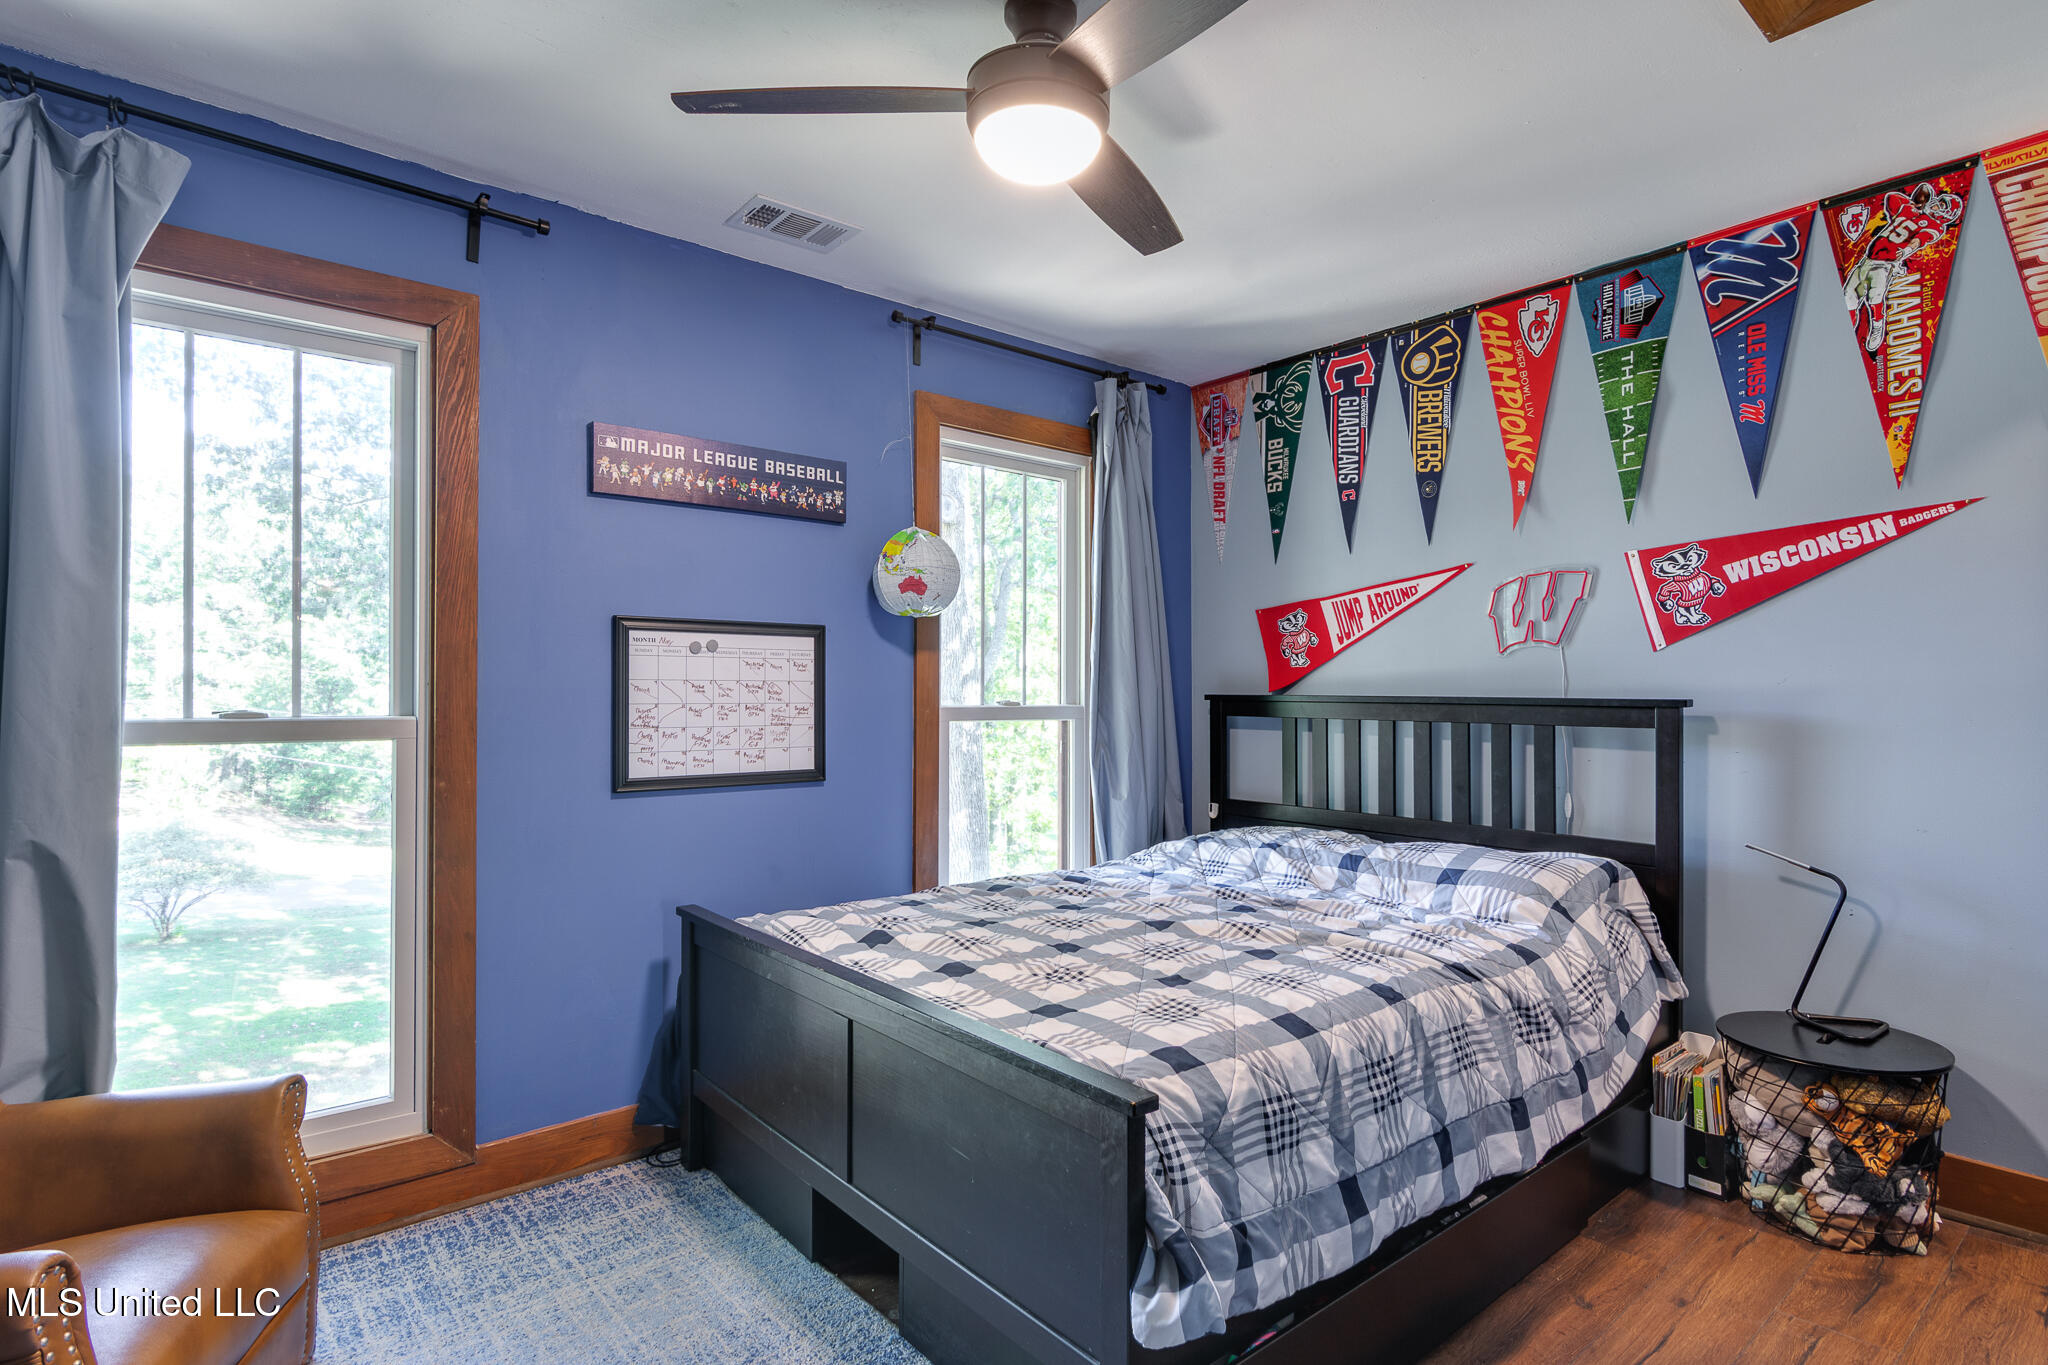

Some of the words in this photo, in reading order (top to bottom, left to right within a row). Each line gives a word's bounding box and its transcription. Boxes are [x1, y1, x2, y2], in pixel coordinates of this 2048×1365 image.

[1847, 213, 1863, 234] KC
[1602, 284, 1614, 310] HALL
[1922, 279, 1935, 312] Patrick
[1527, 309, 1550, 343] KC
[1602, 314, 1613, 340] FAME
[1747, 323, 1767, 354] OLE
[1886, 272, 1924, 397] MAHOMES
[1324, 348, 1376, 396] C
[1514, 339, 1526, 370] SUPER
[1621, 351, 1635, 397] THE
[1876, 355, 1884, 393] QUARTERBACK
[1478, 311, 1537, 473] CHAMPIONS
[1519, 370, 1531, 399] BOWL
[1746, 356, 1767, 397] MISS
[1212, 398, 1223, 446] DRAFT
[1361, 395, 1369, 428] Cleveland
[1443, 386, 1452, 429] Milwaukee
[1525, 399, 1535, 418] LIV
[1889, 398, 1920, 418] II
[1338, 396, 1360, 484] GUARDIANS
[1416, 389, 1443, 473] BREWERS
[1622, 405, 1636, 465] HALL
[620, 436, 686, 461] MAJOR
[693, 448, 758, 472] LEAGUE
[765, 459, 844, 484] BASEBALL
[1212, 455, 1227, 480] NFL
[1267, 438, 1284, 494] BUCKS
[1212, 481, 1227, 524] DRAFT
[1722, 513, 1898, 585] WISCONSIN
[1898, 503, 1957, 528] BADGERS
[1331, 596, 1365, 645] JUMP
[1367, 584, 1419, 625] AROUND
[1488, 570, 1589, 655] W
